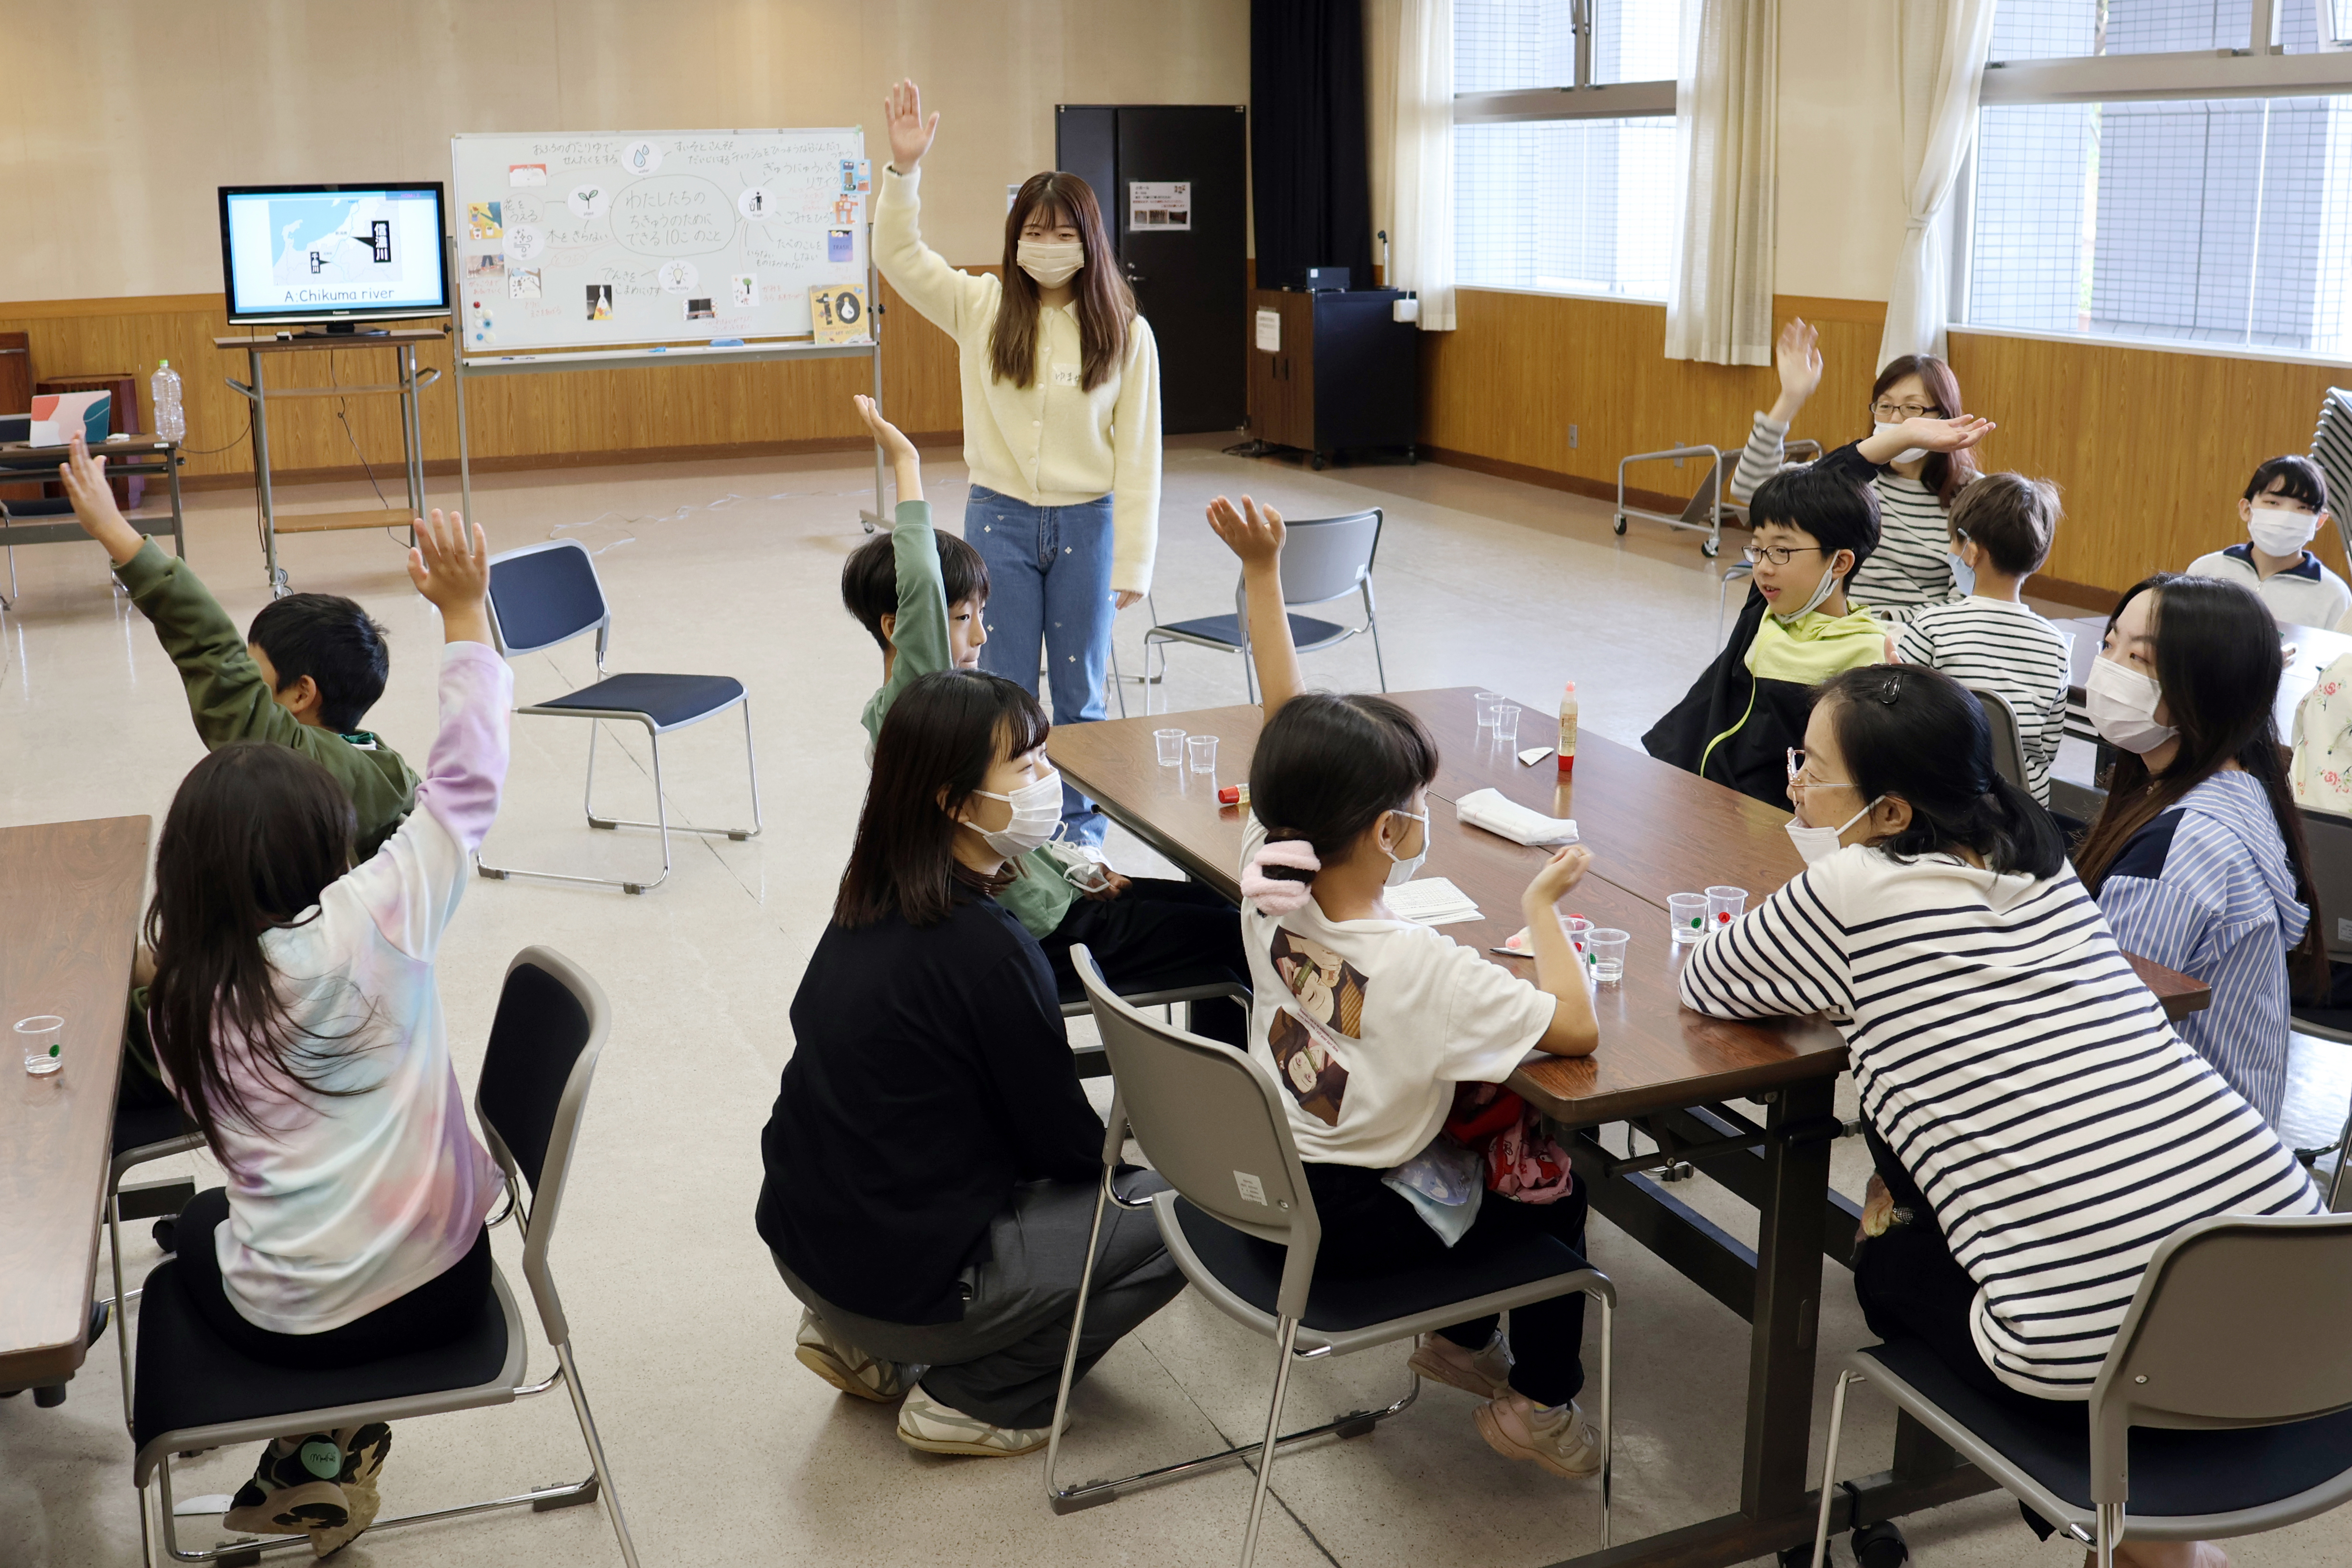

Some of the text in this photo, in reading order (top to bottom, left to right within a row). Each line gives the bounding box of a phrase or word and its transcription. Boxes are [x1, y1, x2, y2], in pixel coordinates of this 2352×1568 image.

[626, 190, 706, 209] わたしたちの
[510, 210, 538, 223] うえる
[630, 213, 713, 229] ちきゅうのために
[374, 223, 388, 261] 信濃川
[747, 250, 774, 258] いらない
[794, 253, 818, 261] しない
[311, 253, 319, 273] 千曲川
[601, 268, 635, 282] でんきを
[362, 288, 394, 299] river
[616, 283, 660, 297] こまめにけす
